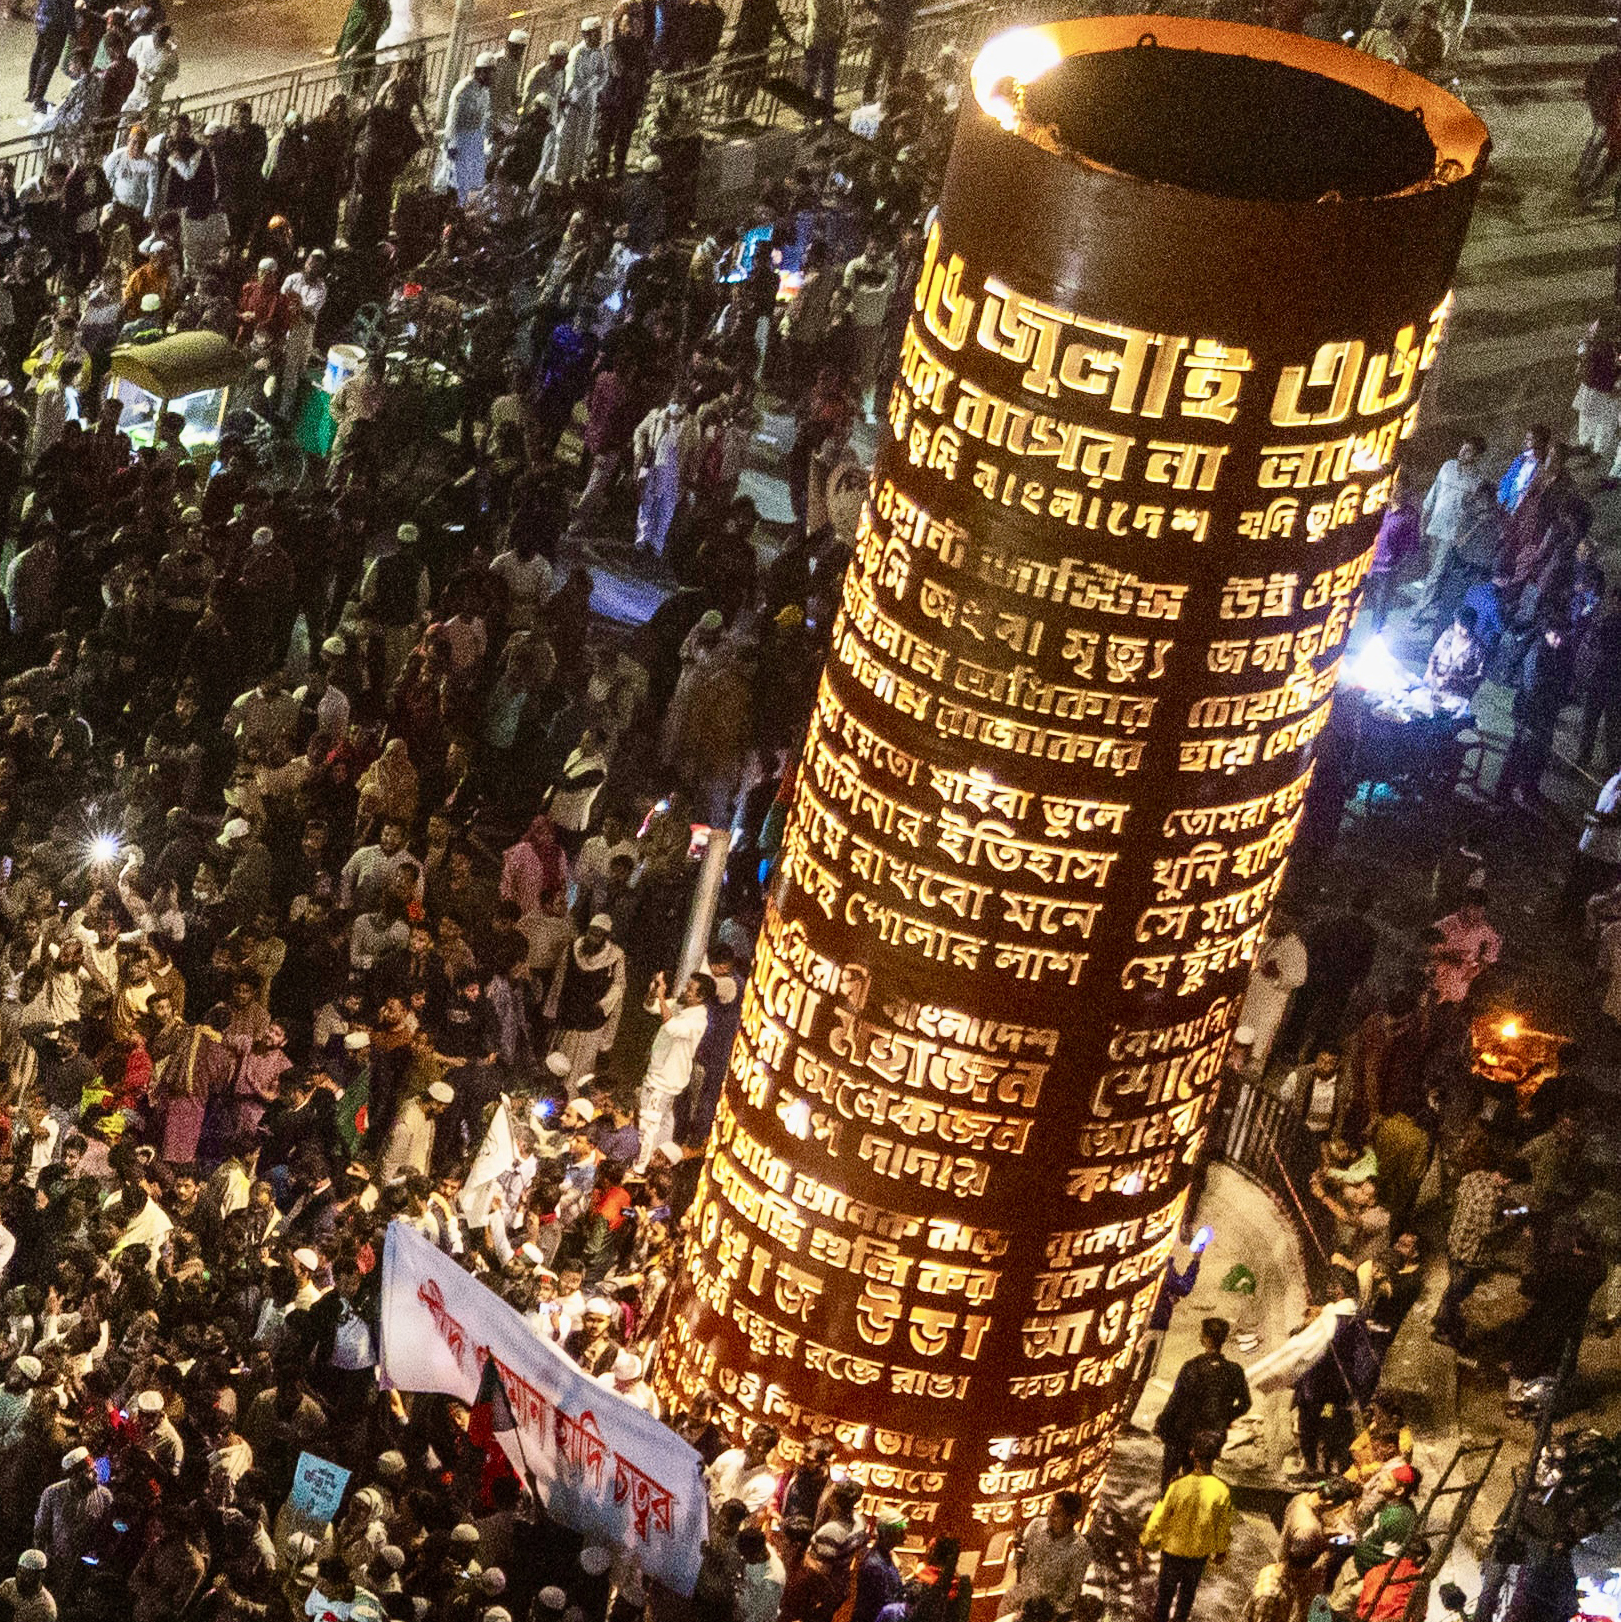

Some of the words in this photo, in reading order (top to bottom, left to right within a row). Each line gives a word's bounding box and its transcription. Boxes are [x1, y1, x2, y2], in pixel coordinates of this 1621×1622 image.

[976, 275, 1253, 424] জুলাই
[1270, 324, 1421, 427] ৩৬
[908, 418, 961, 481] তুমি
[972, 460, 1210, 543] বাংলাদেশ
[1237, 496, 1299, 540] যদি
[1305, 482, 1361, 542] তুমি
[953, 378, 1136, 490] বাপের
[1146, 439, 1230, 492] না
[1220, 572, 1299, 619] উই
[1061, 628, 1174, 683] মৃত্যু
[842, 711, 924, 786] হয়তো
[928, 766, 1036, 821] যাইবা
[1041, 795, 1131, 839] ভুলে
[1163, 796, 1273, 838] তোমরা
[936, 696, 1148, 777] রাজাকার
[813, 741, 932, 848] হাসিনার
[936, 806, 1119, 888] ইতিহাস
[1152, 841, 1228, 902] খুনি
[850, 834, 993, 920] রাখবো
[1000, 889, 1104, 938] মনে
[1135, 904, 1196, 943] সে
[844, 892, 988, 971] পোলার
[994, 942, 1090, 986] লাশ
[1122, 954, 1176, 990] যে
[808, 1227, 915, 1288] গুলি
[916, 1257, 1002, 1307] কর
[804, 1339, 885, 1386] রক্তে
[890, 1365, 971, 1400] রাঙা
[1009, 1370, 1069, 1400] কত
[613, 1449, 675, 1542] চত্বর
